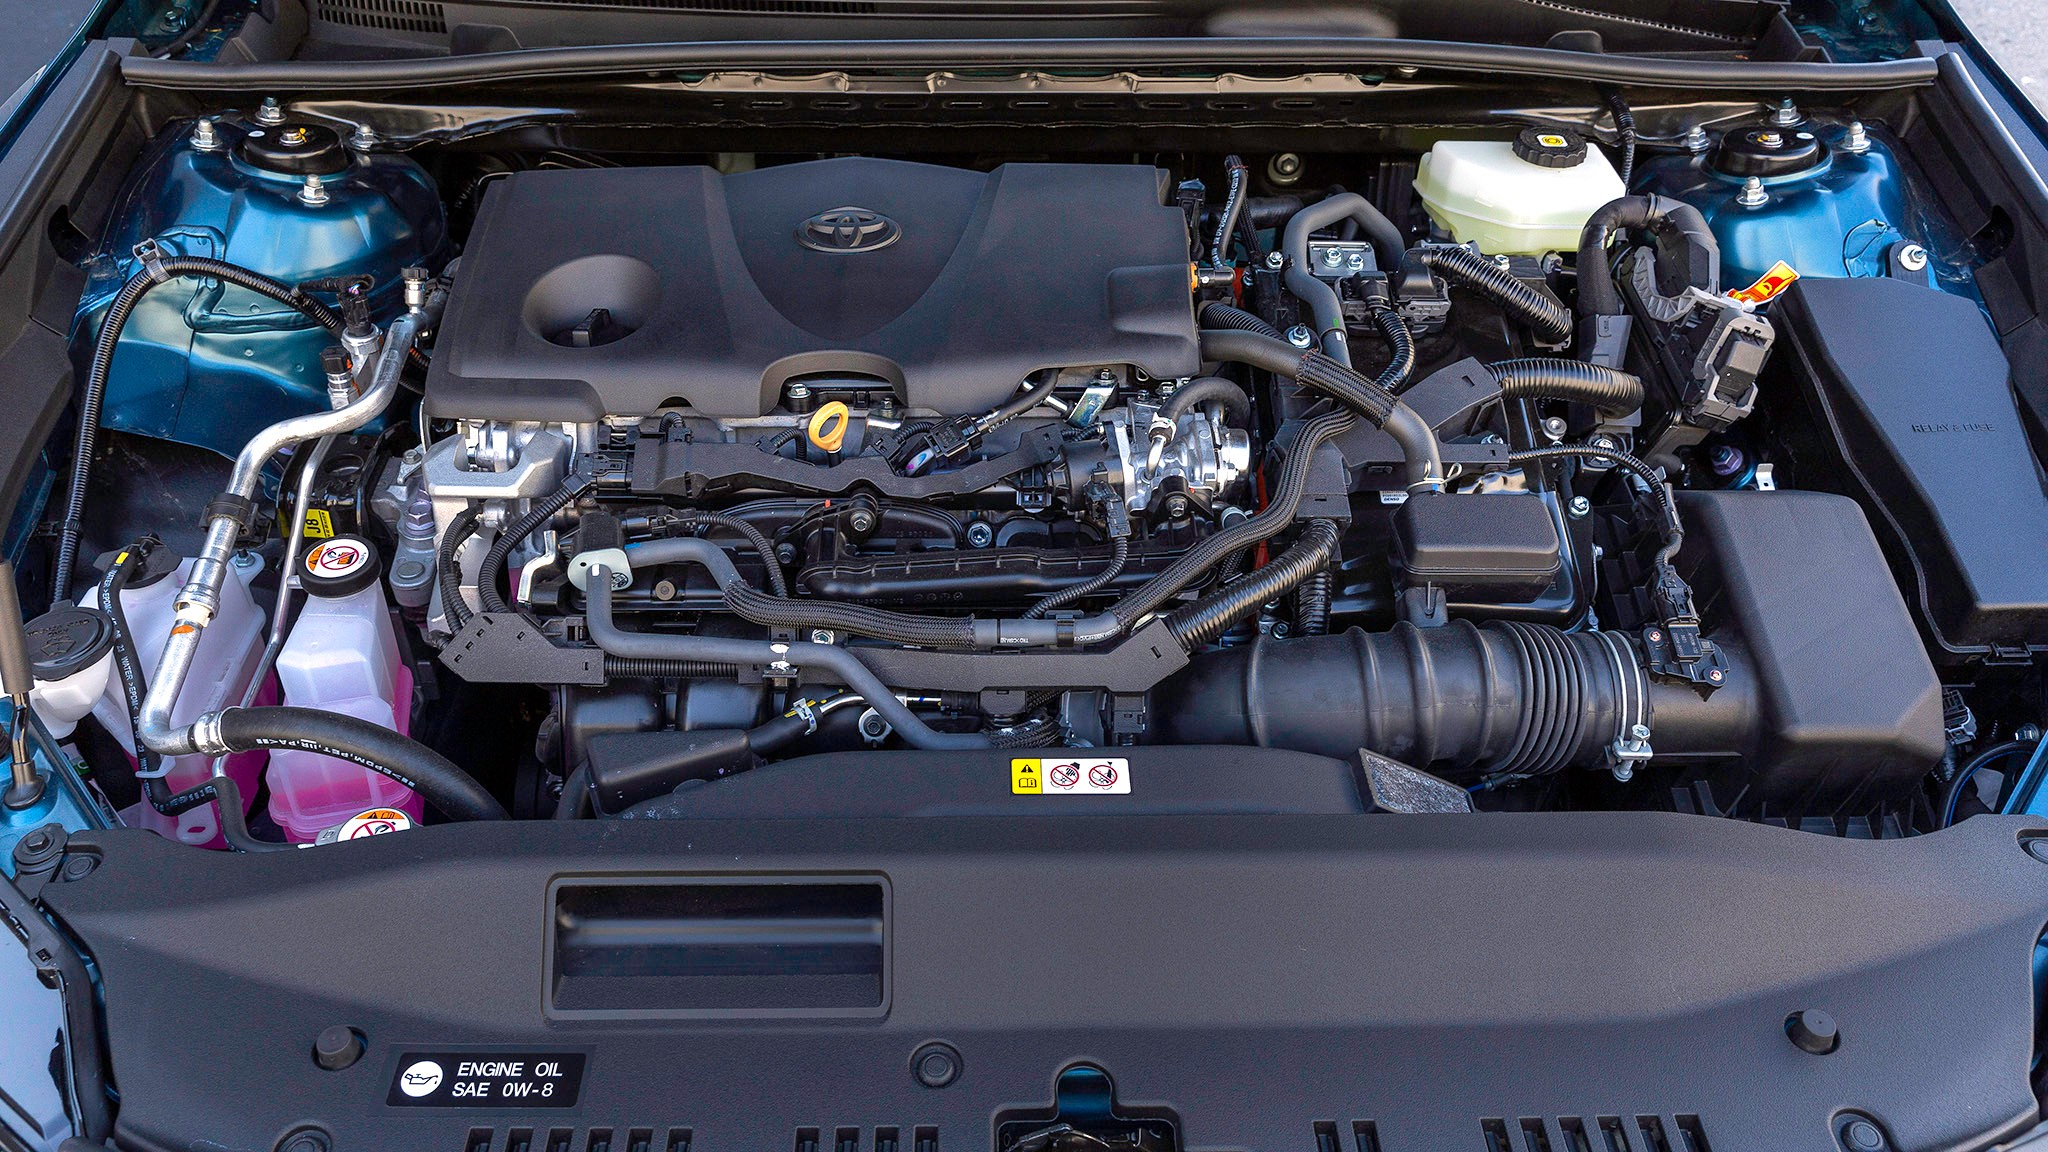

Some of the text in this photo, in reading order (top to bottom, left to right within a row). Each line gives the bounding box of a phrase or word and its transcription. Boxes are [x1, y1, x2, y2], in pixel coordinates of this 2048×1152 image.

[1911, 423, 1995, 433] RELAY & FUSE
[305, 518, 321, 534] J8
[121, 656, 134, 681] WATER
[457, 1061, 563, 1077] ENGINE OIL
[451, 1081, 554, 1098] SAE 0W-8
